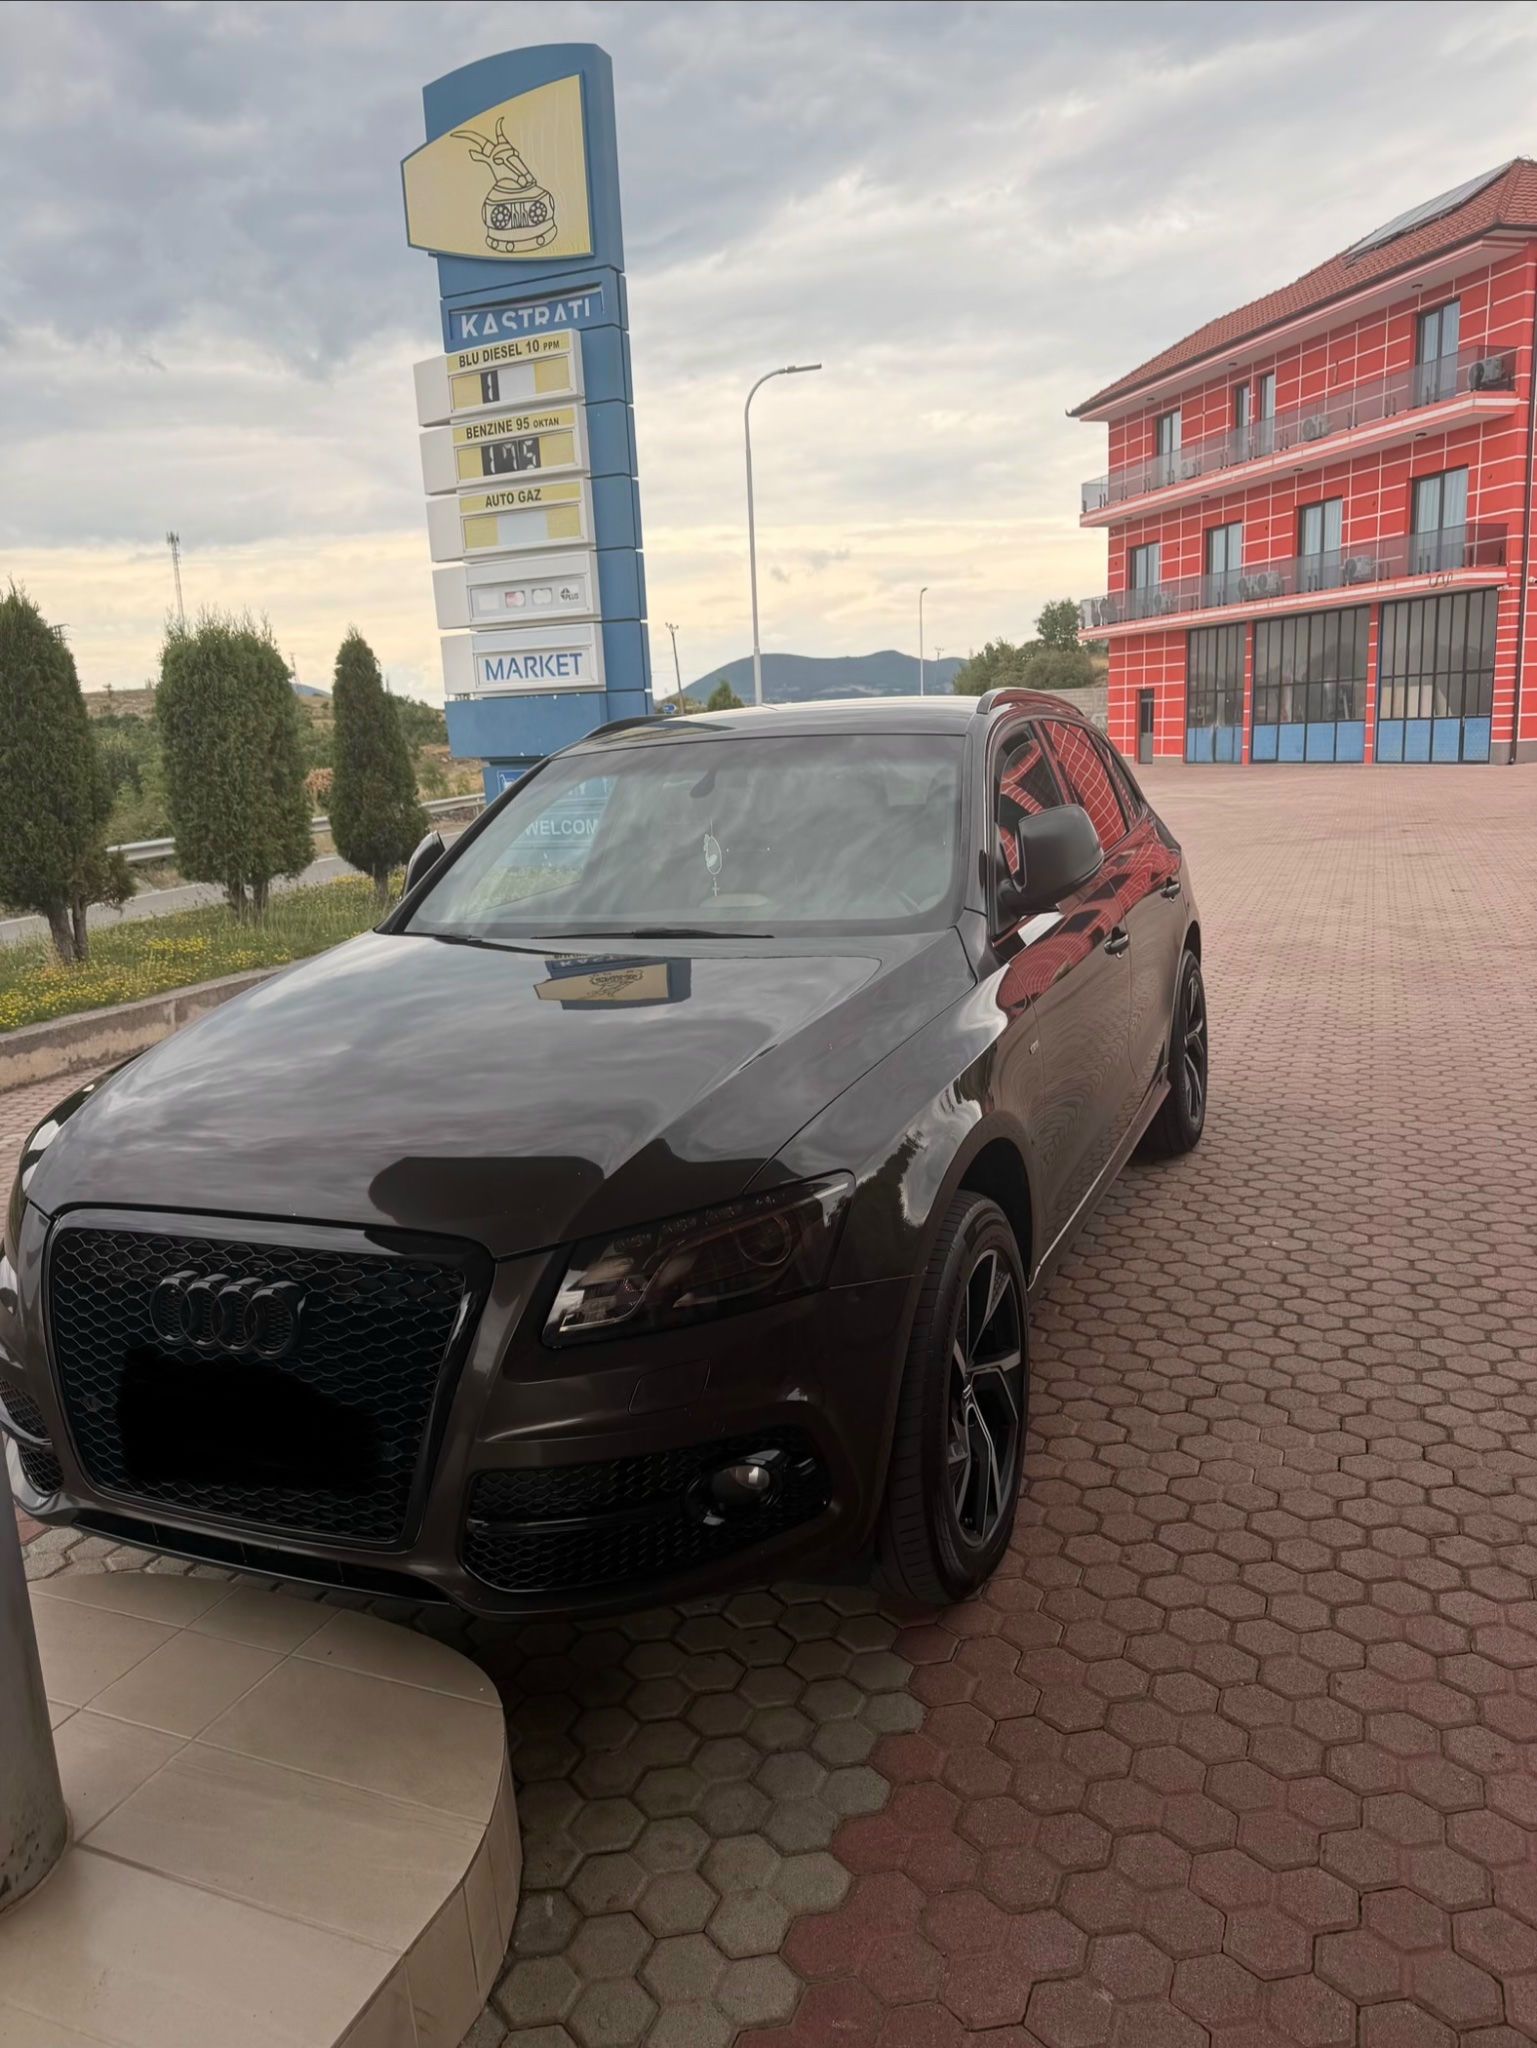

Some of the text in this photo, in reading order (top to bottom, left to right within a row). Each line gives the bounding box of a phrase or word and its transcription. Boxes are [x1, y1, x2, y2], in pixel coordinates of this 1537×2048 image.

[461, 298, 590, 339] KASTRATI
[458, 339, 560, 368] BLU DIESEL 10 PPM
[466, 416, 560, 440] BENZINE 95 OKTAN
[489, 440, 538, 474] 175
[485, 488, 542, 508] AUTO GAZ
[485, 652, 583, 681] MARKET
